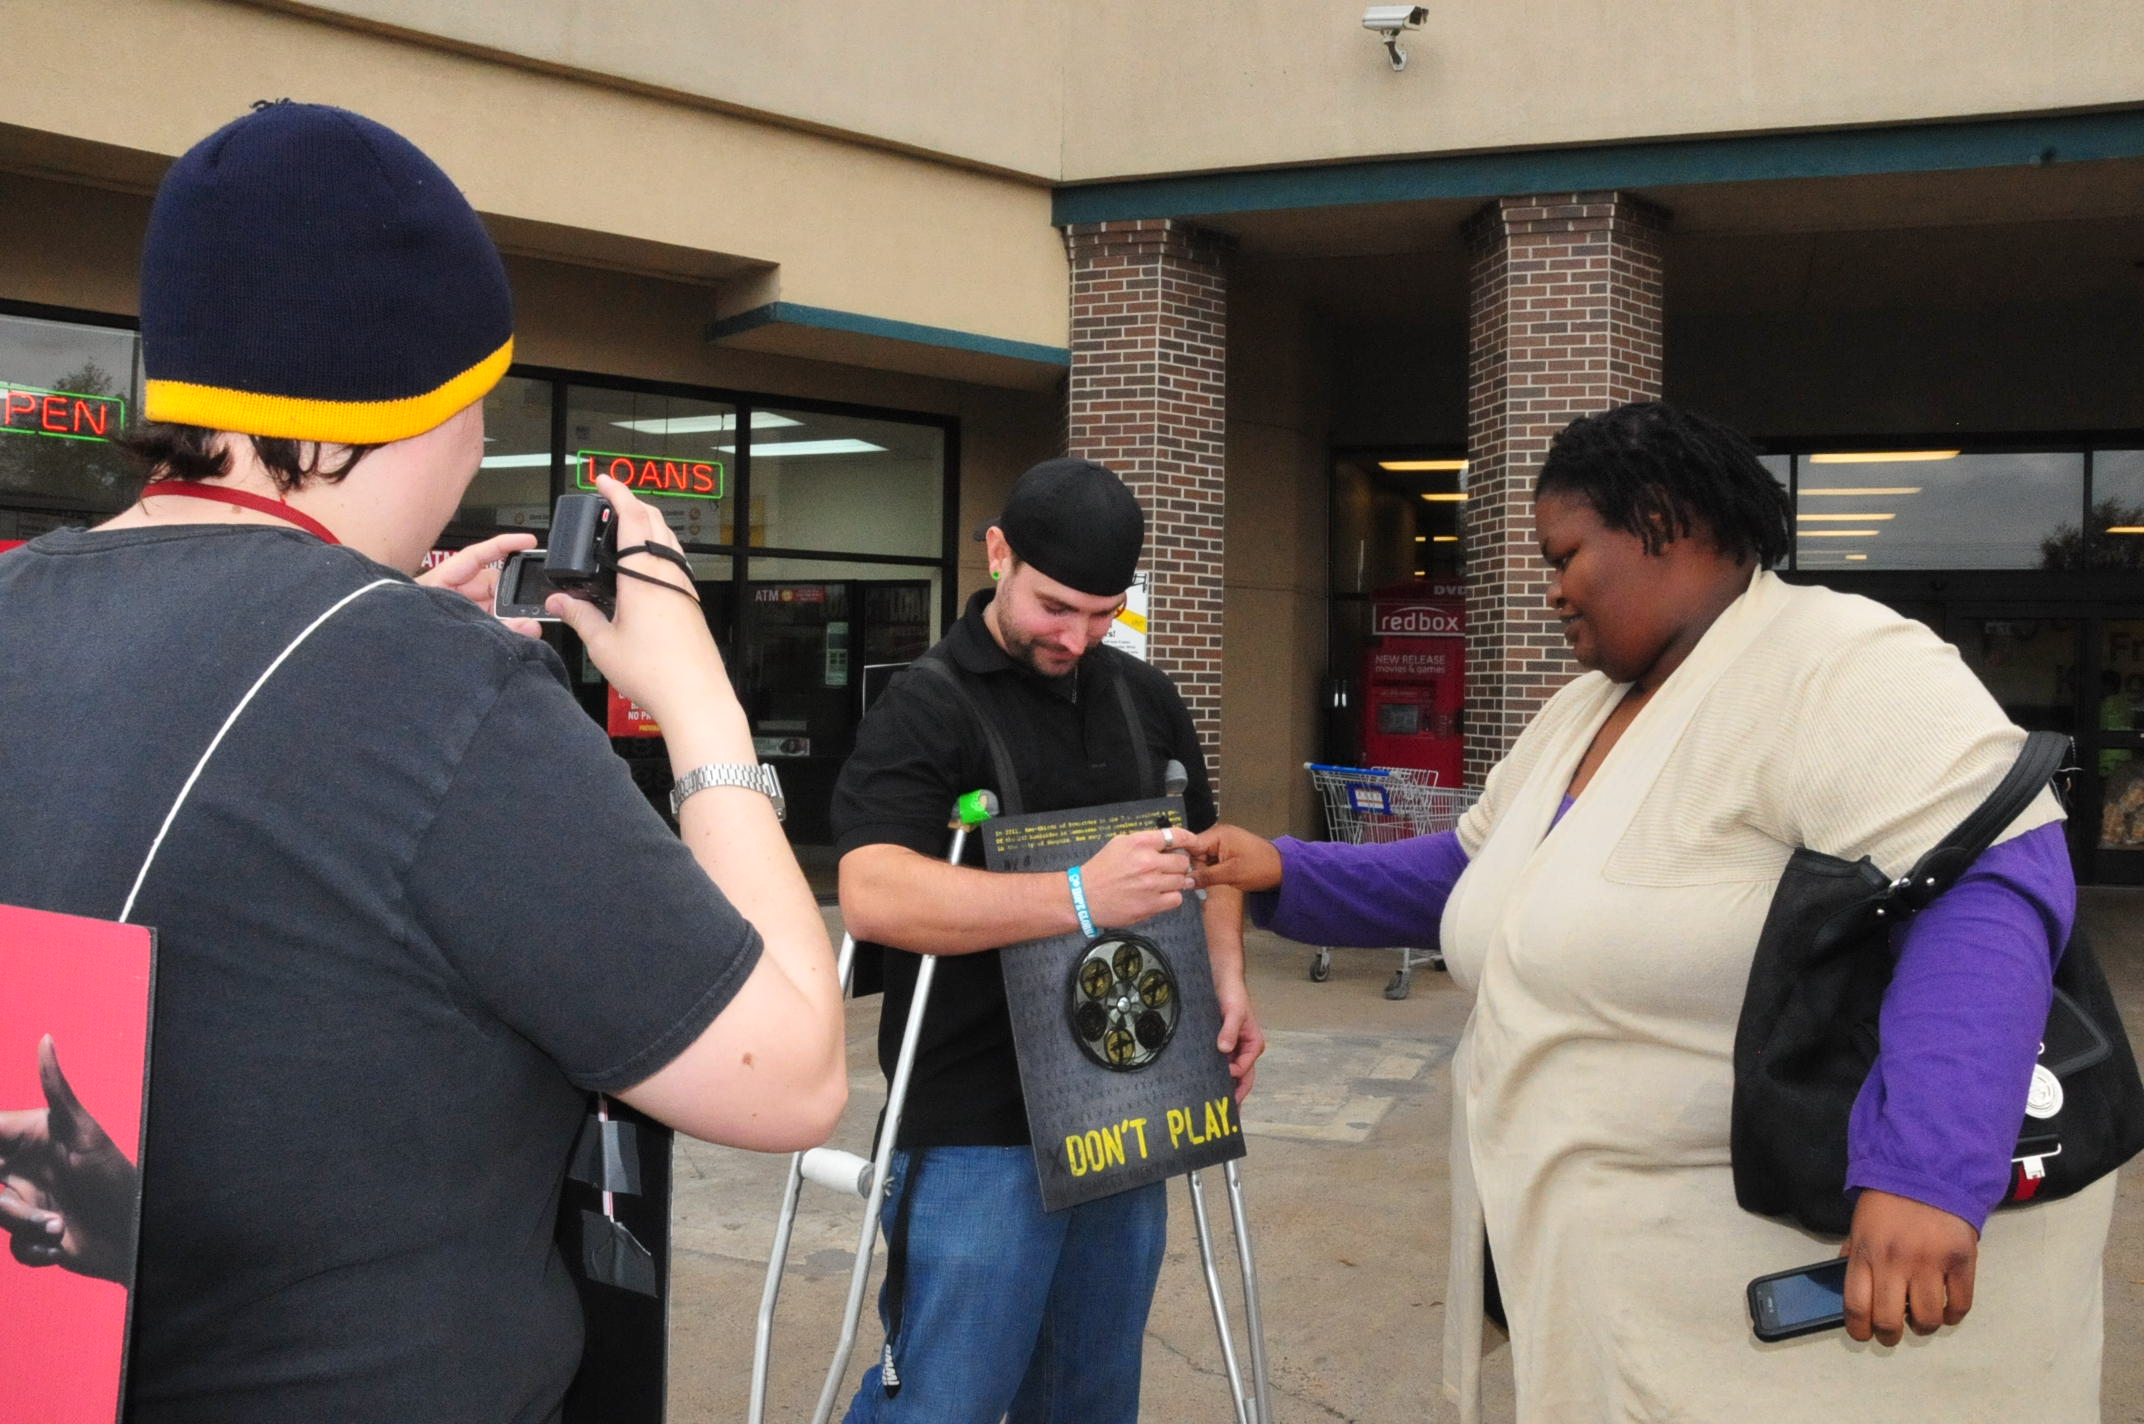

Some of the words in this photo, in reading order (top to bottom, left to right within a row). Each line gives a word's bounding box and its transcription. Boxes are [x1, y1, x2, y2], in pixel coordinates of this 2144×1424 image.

[588, 456, 714, 492] LOANS
[755, 589, 779, 602] ATM
[1381, 612, 1460, 632] redbox
[1375, 654, 1399, 665] NEW
[1402, 654, 1446, 665] RELEASE
[1065, 1117, 1148, 1177] DON'T
[1166, 1096, 1238, 1149] PLAY.
